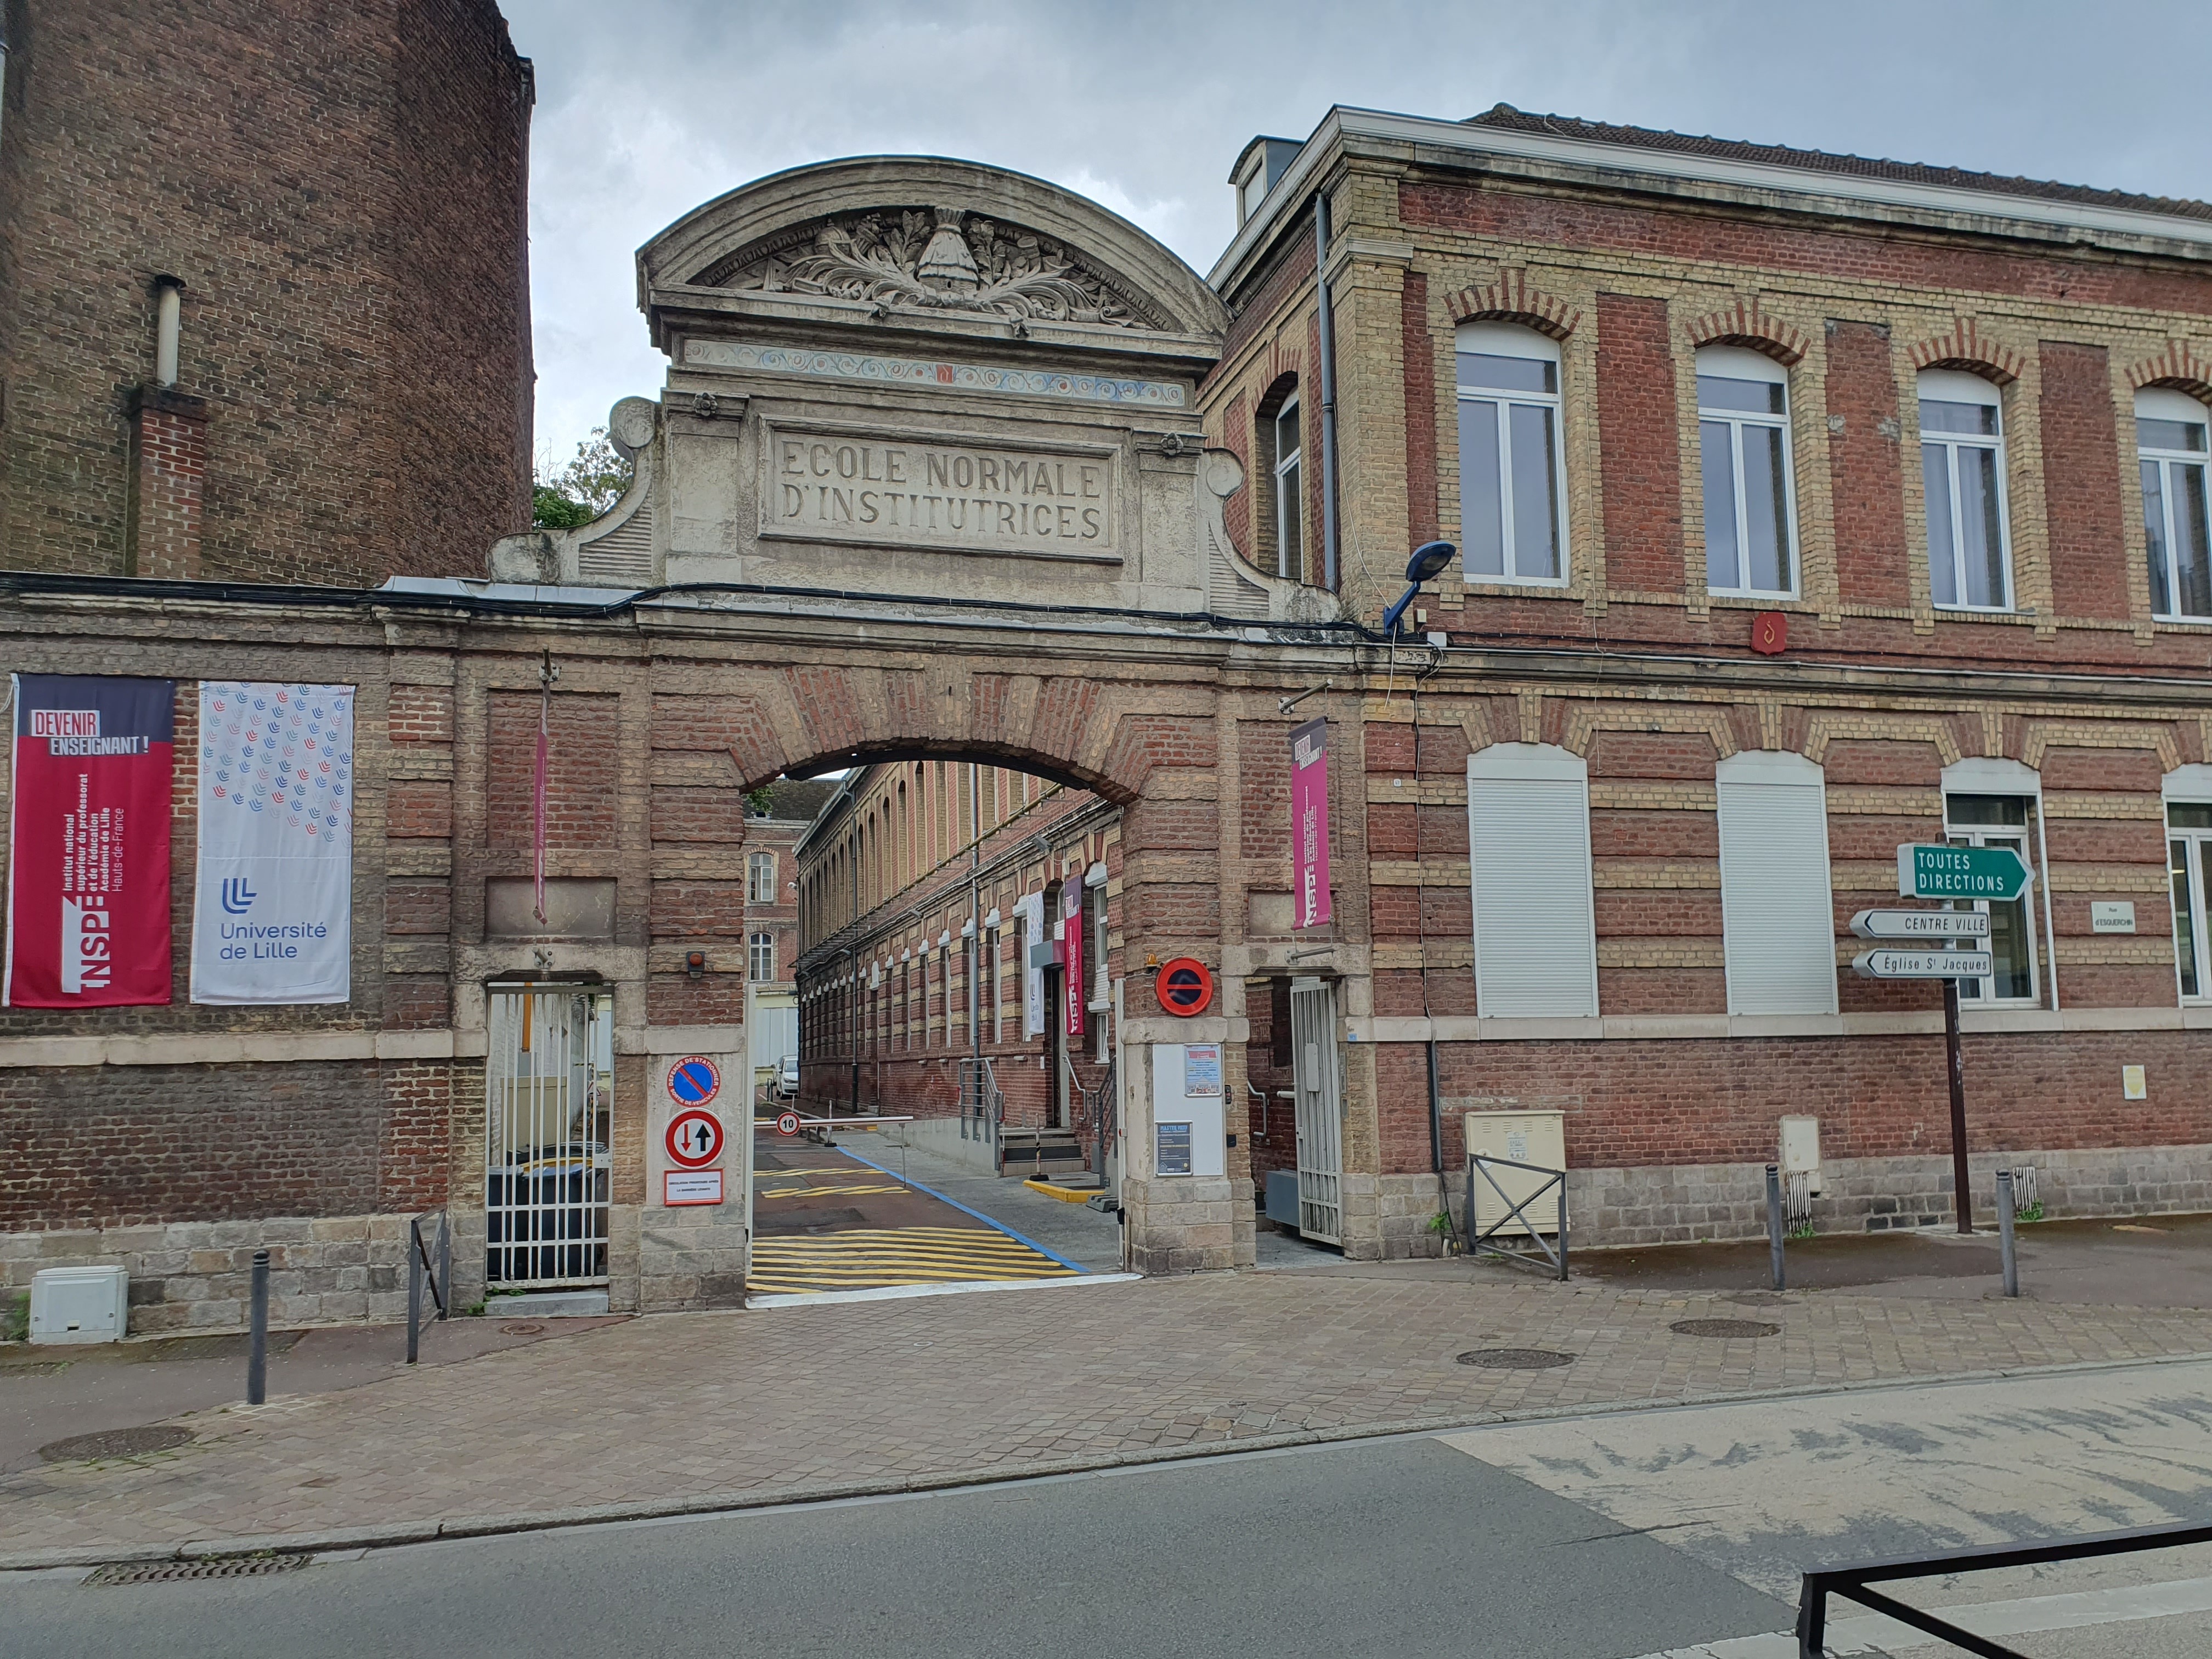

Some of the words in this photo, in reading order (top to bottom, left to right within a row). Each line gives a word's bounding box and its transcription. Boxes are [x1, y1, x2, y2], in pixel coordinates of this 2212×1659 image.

[781, 441, 906, 483] ECOLE
[926, 453, 1101, 498] NORMALE
[781, 483, 1101, 539] D'INSTITUTRICES
[35, 712, 97, 736] DEVENIR
[50, 737, 139, 755] ENSEIGNANT
[1295, 736, 1310, 759] DEVENIR
[76, 774, 88, 829] professorat
[100, 808, 110, 828] Lille
[63, 814, 75, 853] national
[76, 832, 87, 843] du
[87, 813, 99, 865] l'éducation
[100, 831, 109, 842] de
[111, 808, 124, 892] Hauts-de-France
[76, 846, 88, 892] supérieur
[100, 845, 110, 892] Académie
[1918, 852, 1971, 870] TOUTES
[63, 856, 74, 891] Institut
[88, 868, 98, 879] de
[1919, 873, 2004, 891] DIRECTIONS
[88, 882, 98, 892] et
[221, 921, 327, 939] Université
[1905, 917, 1948, 931] CENTRE
[1956, 918, 1985, 931] VILLE
[220, 943, 247, 960] de
[254, 942, 297, 958] Lille
[1884, 954, 1920, 973] Église
[1943, 957, 1987, 973] Jacques
[668, 1060, 685, 1086] DEFENSE
[695, 1057, 719, 1086] STATIONNER
[670, 1088, 685, 1103] SORTIE
[692, 1088, 717, 1105] VEHICULES
[783, 1119, 794, 1128] 10
